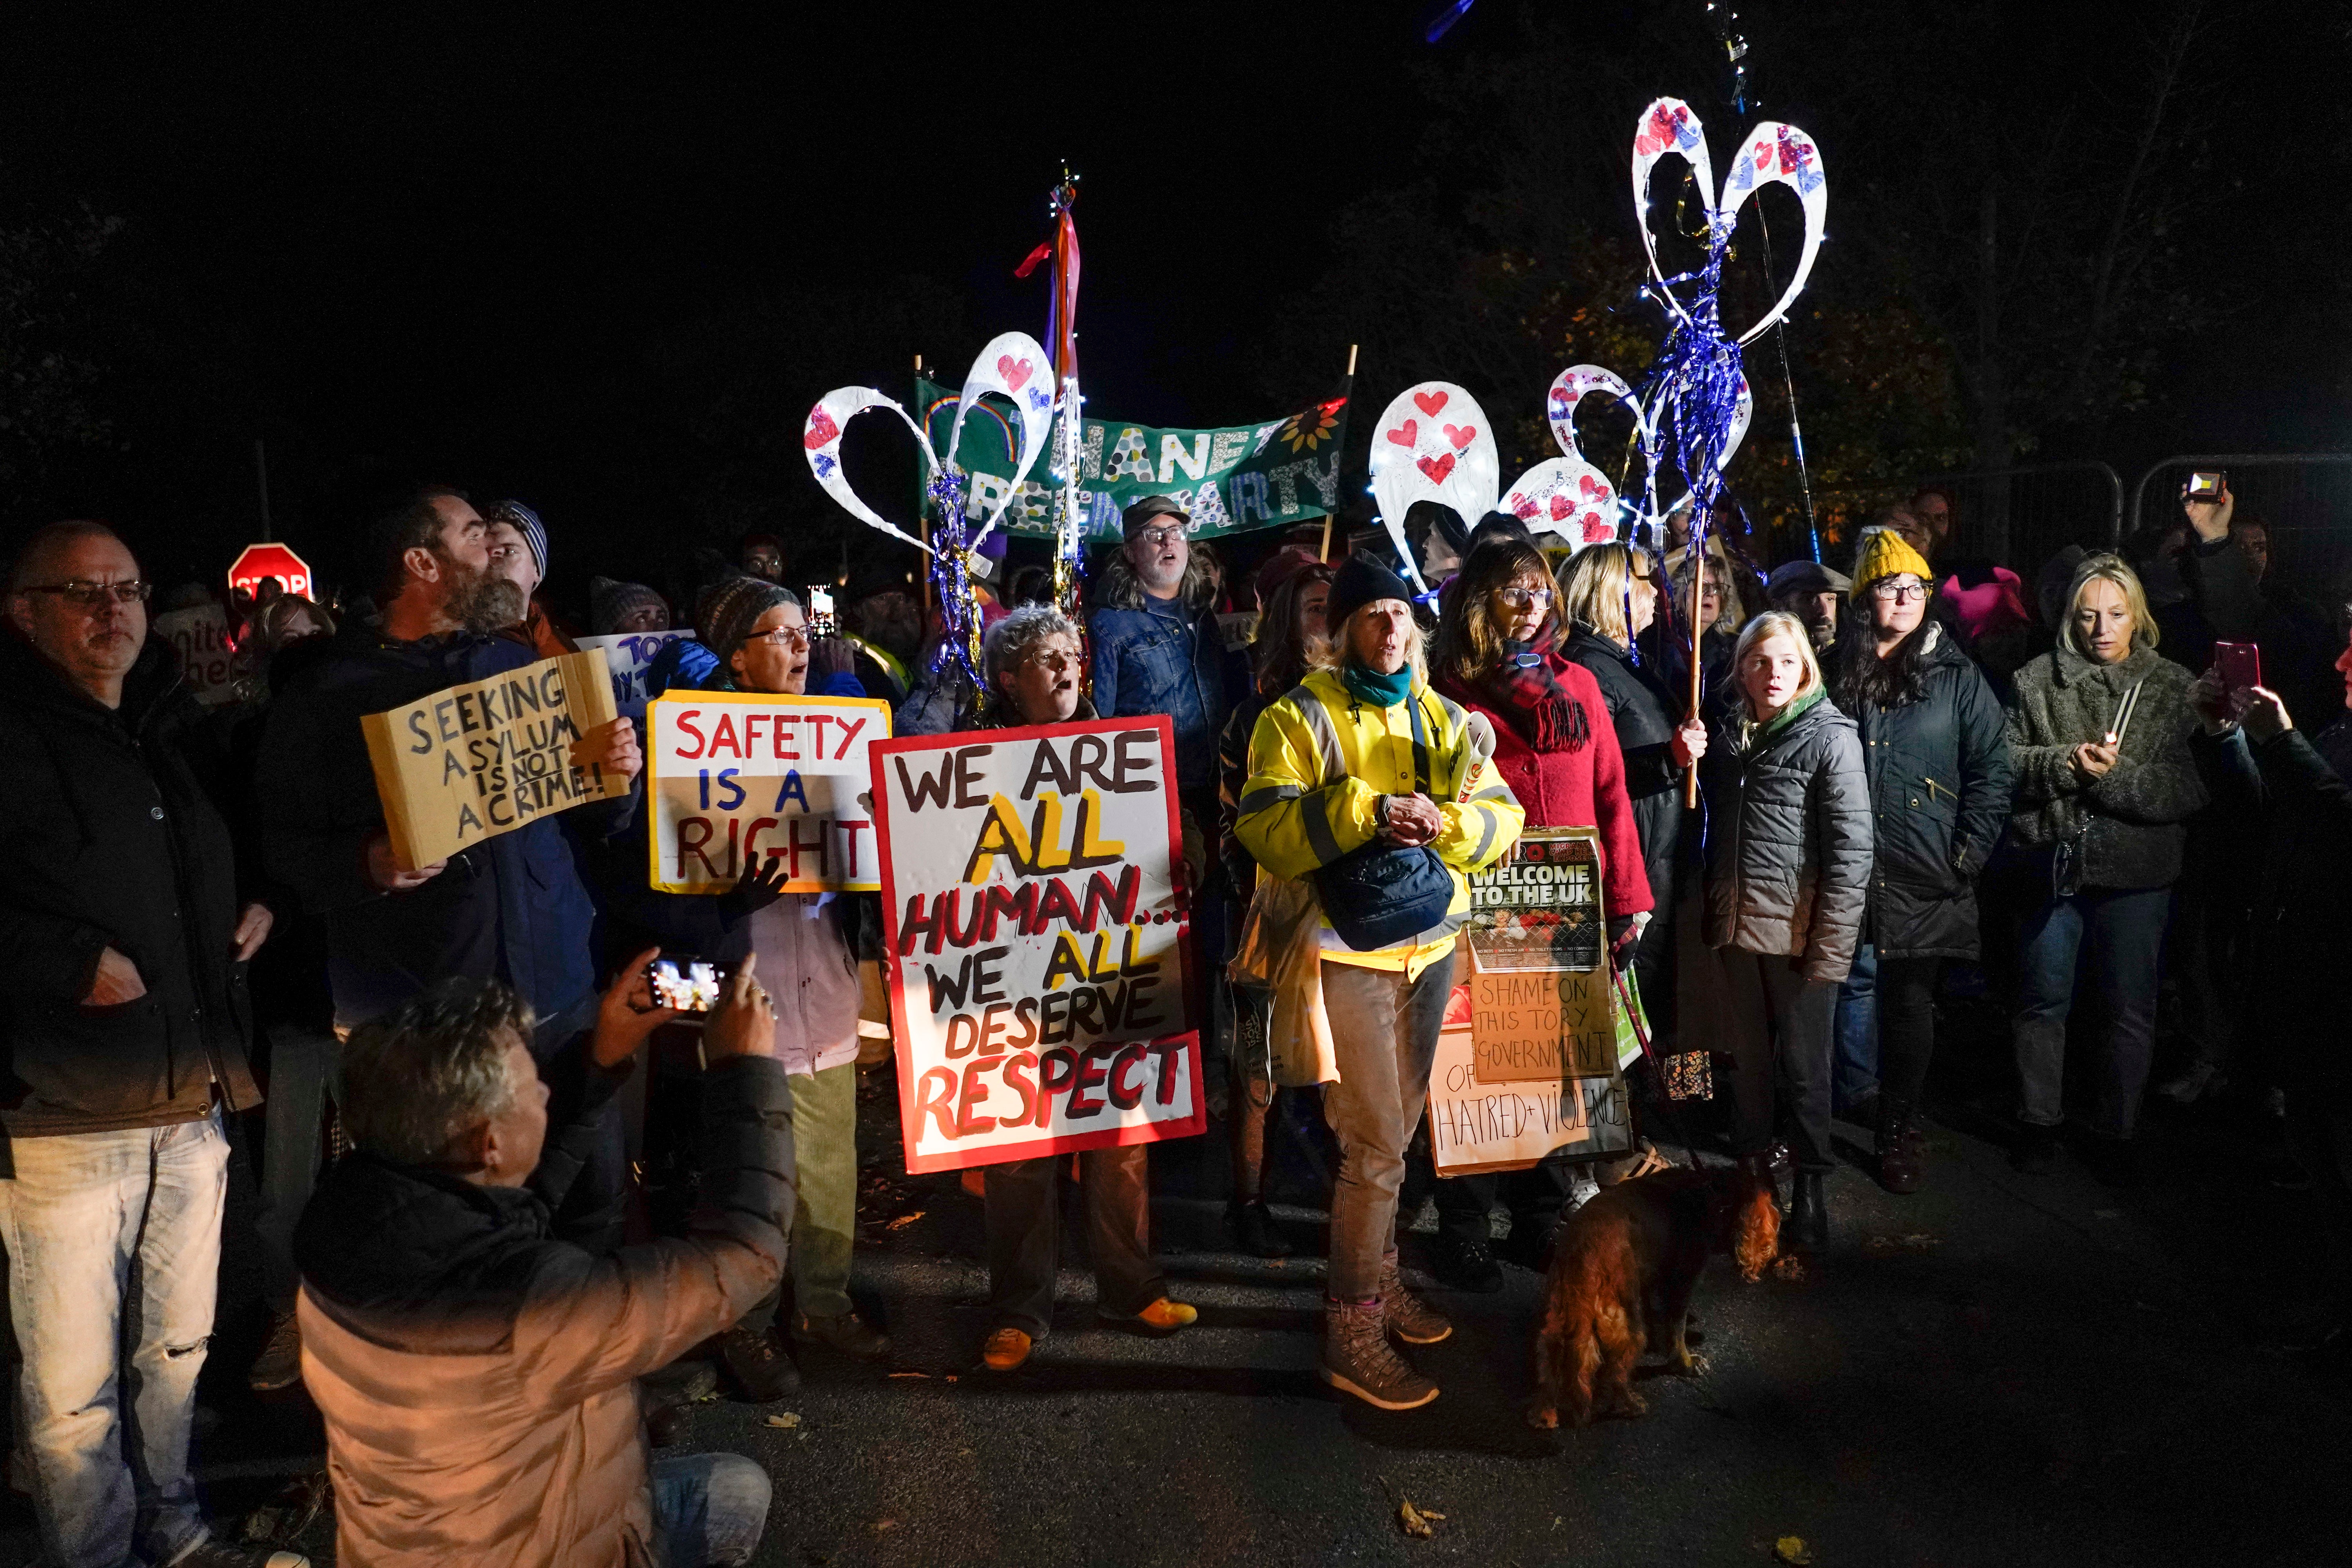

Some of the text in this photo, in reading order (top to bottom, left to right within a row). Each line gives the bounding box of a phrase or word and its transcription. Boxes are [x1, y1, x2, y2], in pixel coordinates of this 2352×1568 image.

[408, 667, 564, 755] SEEKING
[676, 710, 866, 760] SAFETY
[443, 712, 582, 786] ASYLUM
[475, 744, 565, 797] IS NOT
[894, 730, 1160, 813] WE ARE
[457, 762, 605, 839] A CRIME!
[699, 768, 810, 813] IS A
[677, 817, 869, 879] RIGHT
[962, 788, 1125, 885] ALL
[1472, 866, 1590, 886] WELCOME
[1472, 884, 1594, 906] TO THE UK
[924, 923, 1161, 1014] WE ALL
[1480, 978, 1588, 1007] SHAME ON
[945, 977, 1166, 1060] DESERVE
[1475, 1007, 1588, 1033] THIS TORY
[1478, 1031, 1607, 1070] GOVERNMENT
[913, 1041, 1189, 1142] RESPECT
[1537, 1083, 1626, 1134] VIOLENCE
